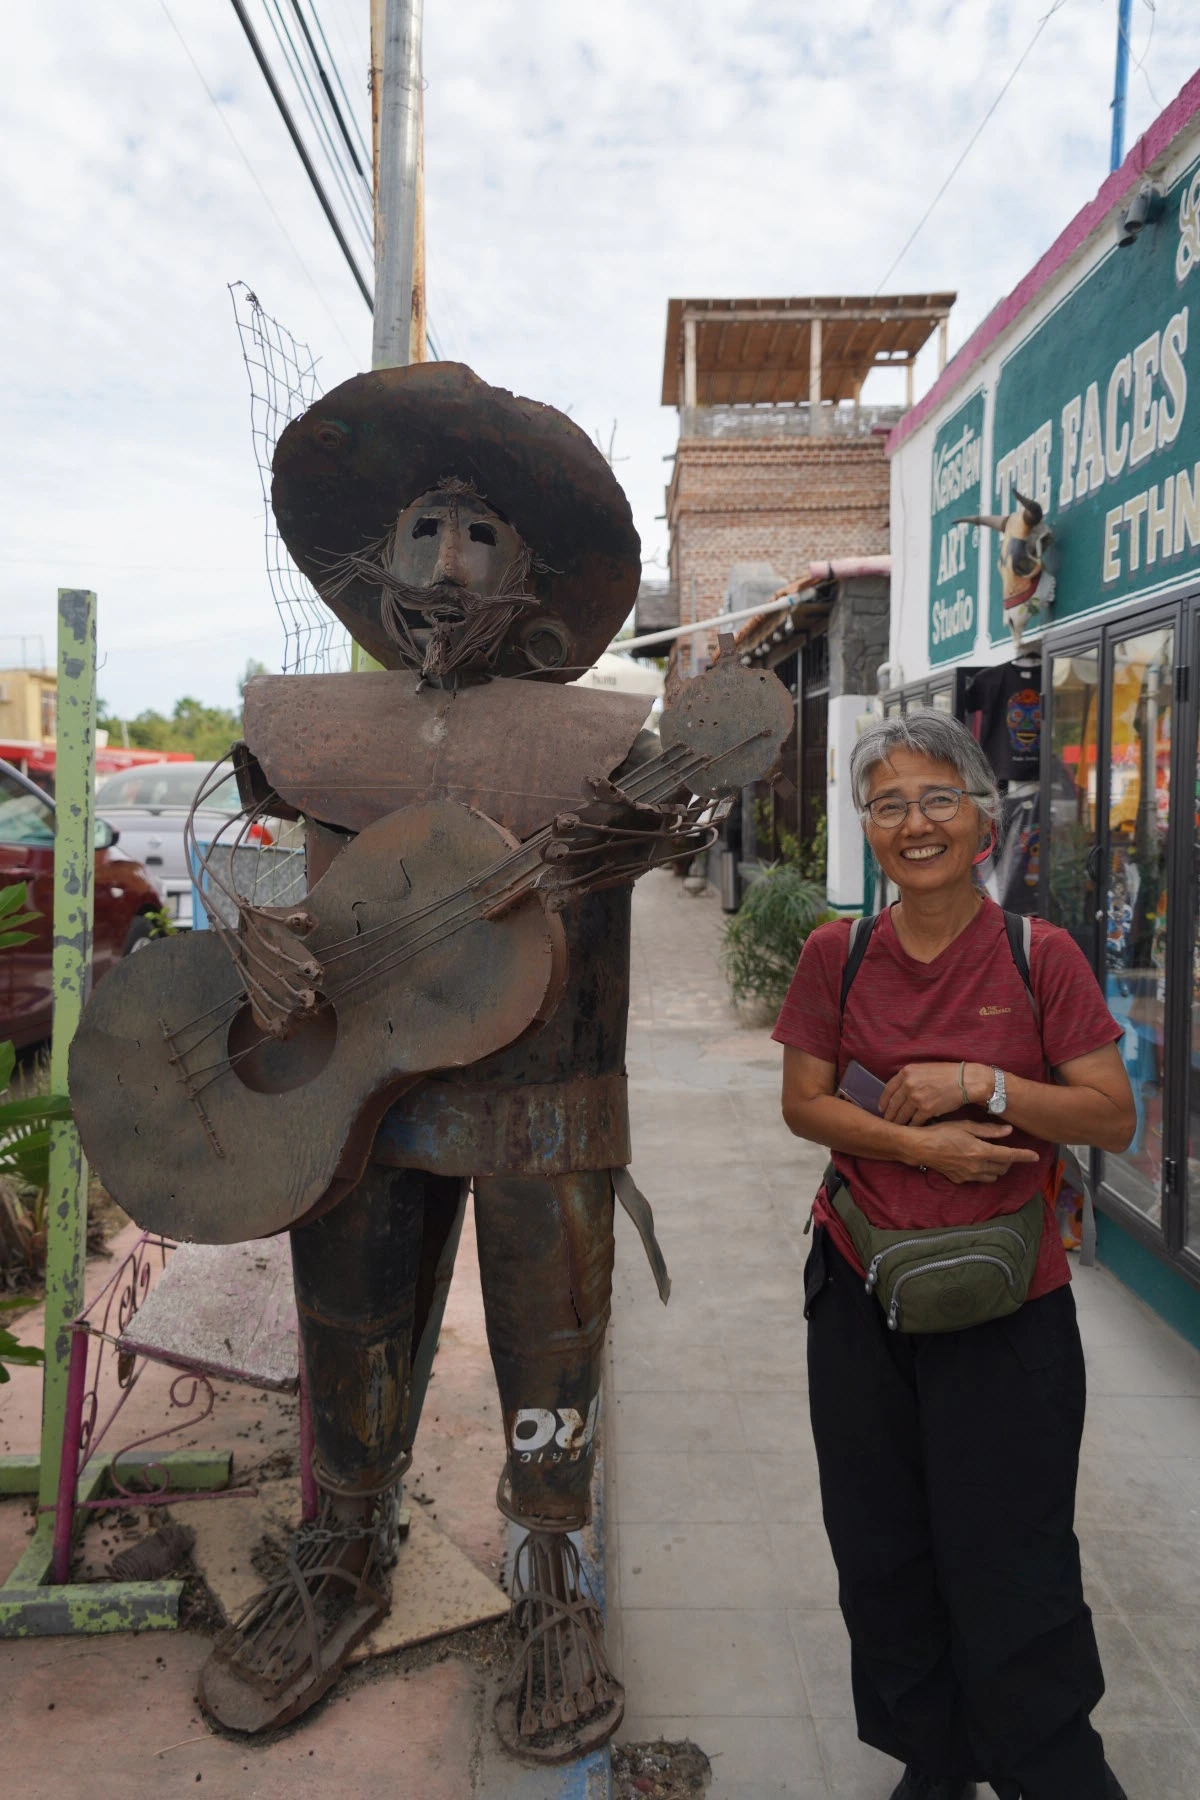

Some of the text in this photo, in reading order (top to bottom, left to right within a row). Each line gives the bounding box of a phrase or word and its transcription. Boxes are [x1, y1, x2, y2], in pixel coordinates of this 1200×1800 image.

[996, 305, 1189, 541] THE FACES
[936, 521, 969, 586] ART
[1103, 460, 1200, 584] ETHN
[932, 588, 973, 645] Studio
